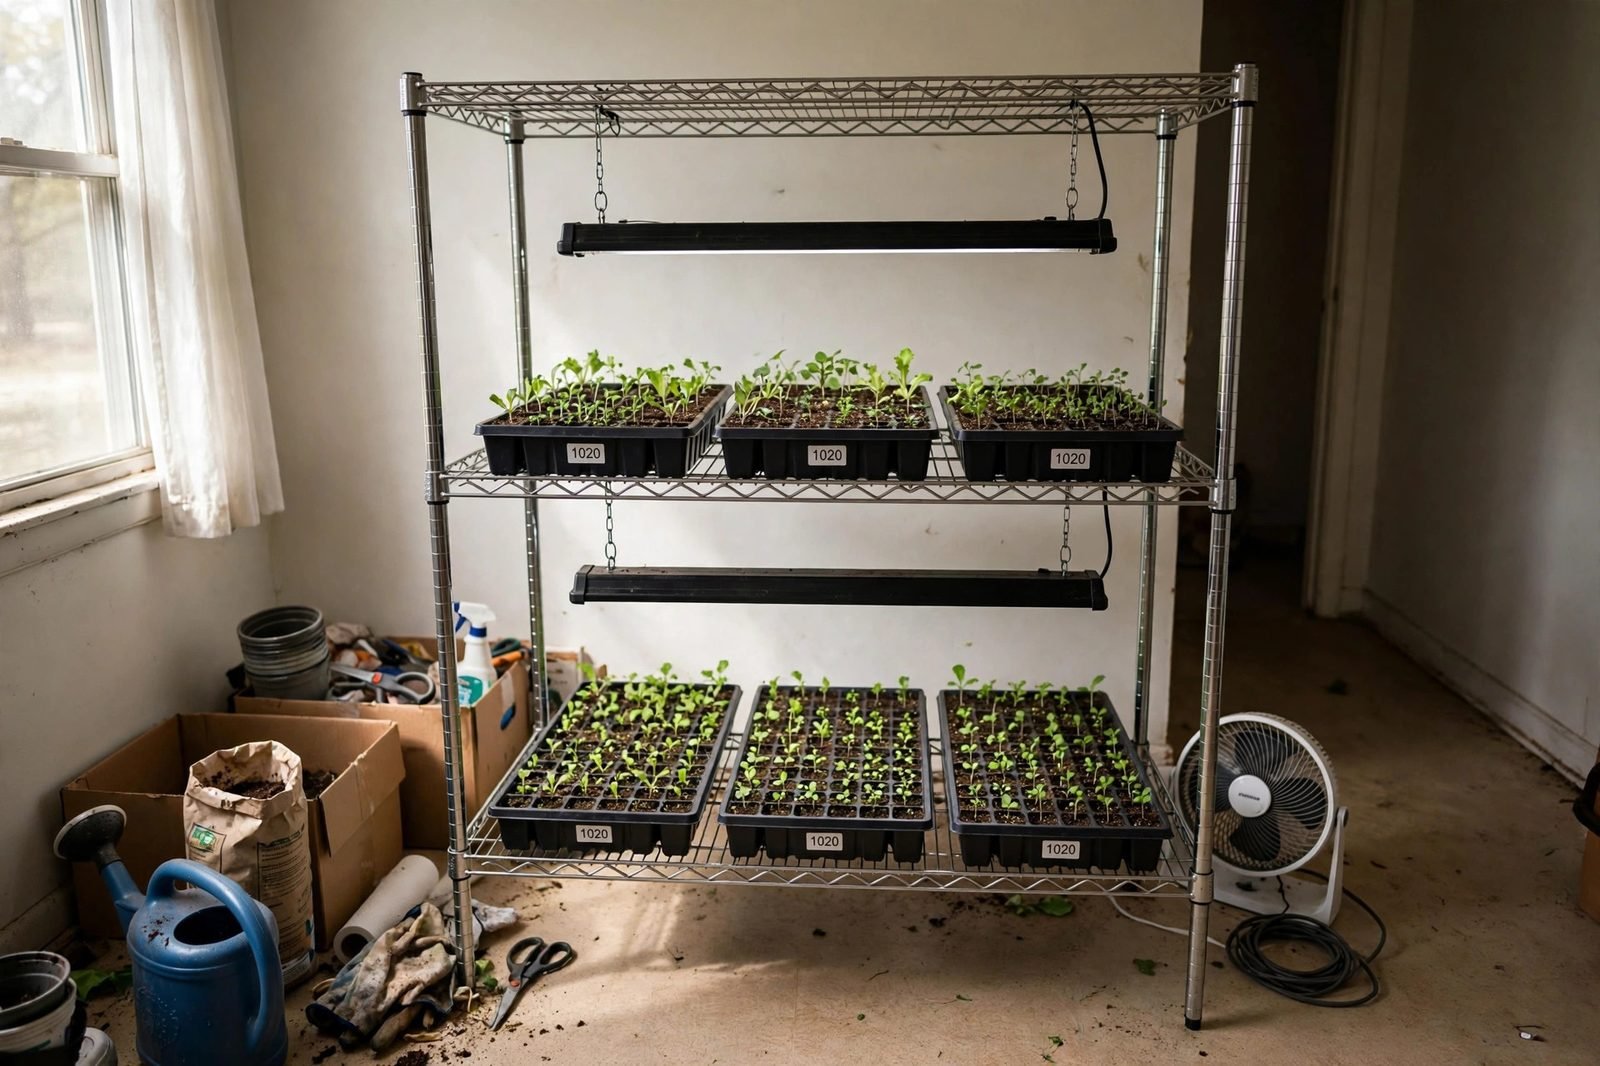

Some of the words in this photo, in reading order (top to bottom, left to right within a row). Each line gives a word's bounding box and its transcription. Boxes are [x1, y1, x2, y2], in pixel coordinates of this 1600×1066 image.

[572, 448, 601, 460] 1020
[813, 449, 843, 461] 1020
[1056, 453, 1086, 465] 1020
[580, 828, 608, 839] 1020
[811, 836, 840, 847] 1020
[1047, 843, 1076, 855] 1020
